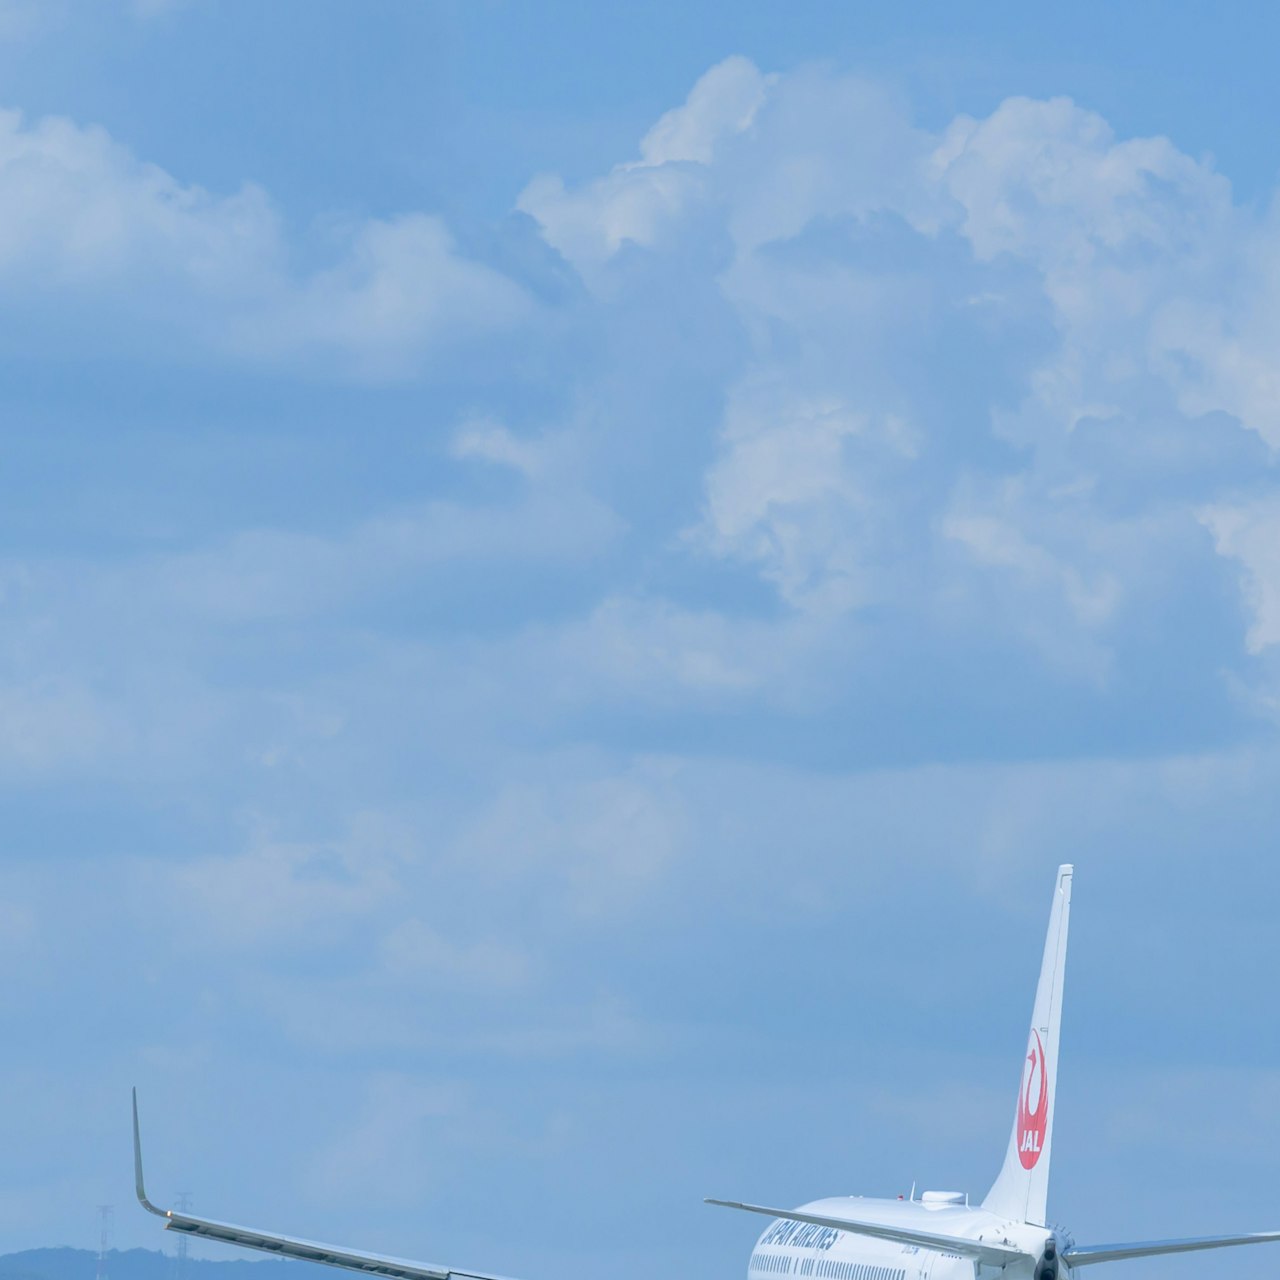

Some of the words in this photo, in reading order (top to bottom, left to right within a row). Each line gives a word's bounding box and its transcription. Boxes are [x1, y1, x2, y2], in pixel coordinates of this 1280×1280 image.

[1020, 1130, 1041, 1151] JAL
[761, 1219, 800, 1246] JAPAN
[789, 1222, 838, 1250] AIRLINES
